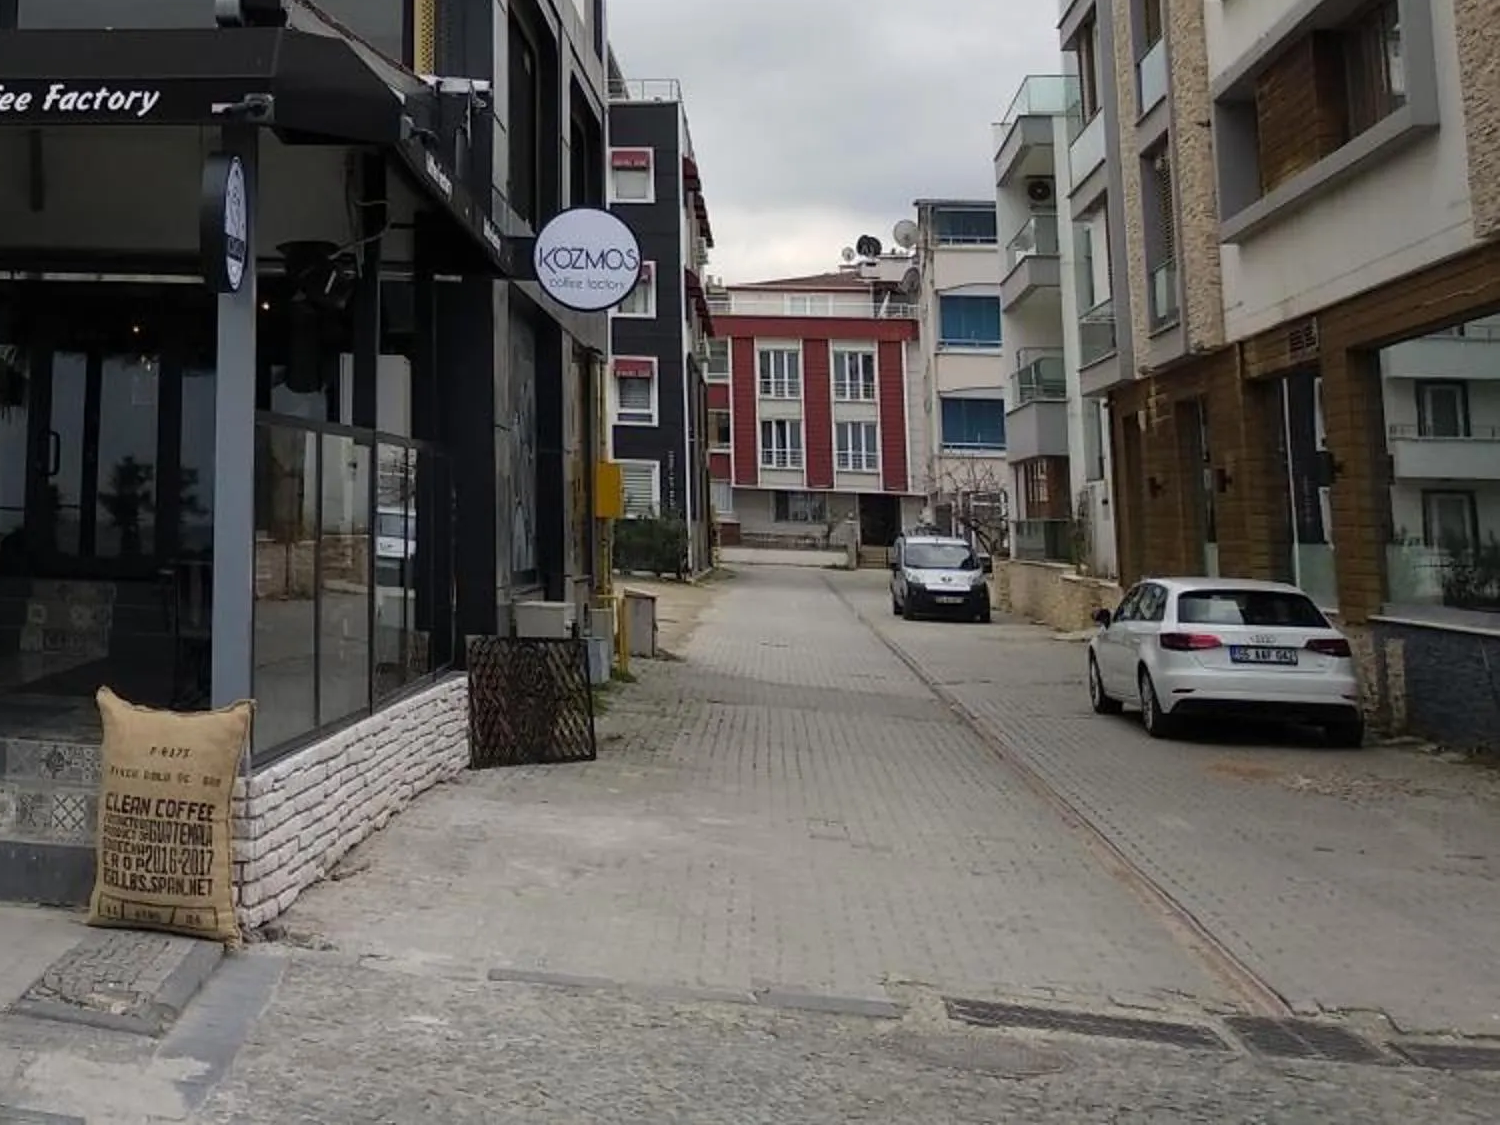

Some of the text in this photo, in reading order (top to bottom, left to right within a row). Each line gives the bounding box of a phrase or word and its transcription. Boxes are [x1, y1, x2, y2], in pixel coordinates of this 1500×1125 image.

[42, 83, 160, 116] Factory
[538, 246, 639, 274] KOZMOS
[105, 792, 216, 822] CLEAN COFFEE
